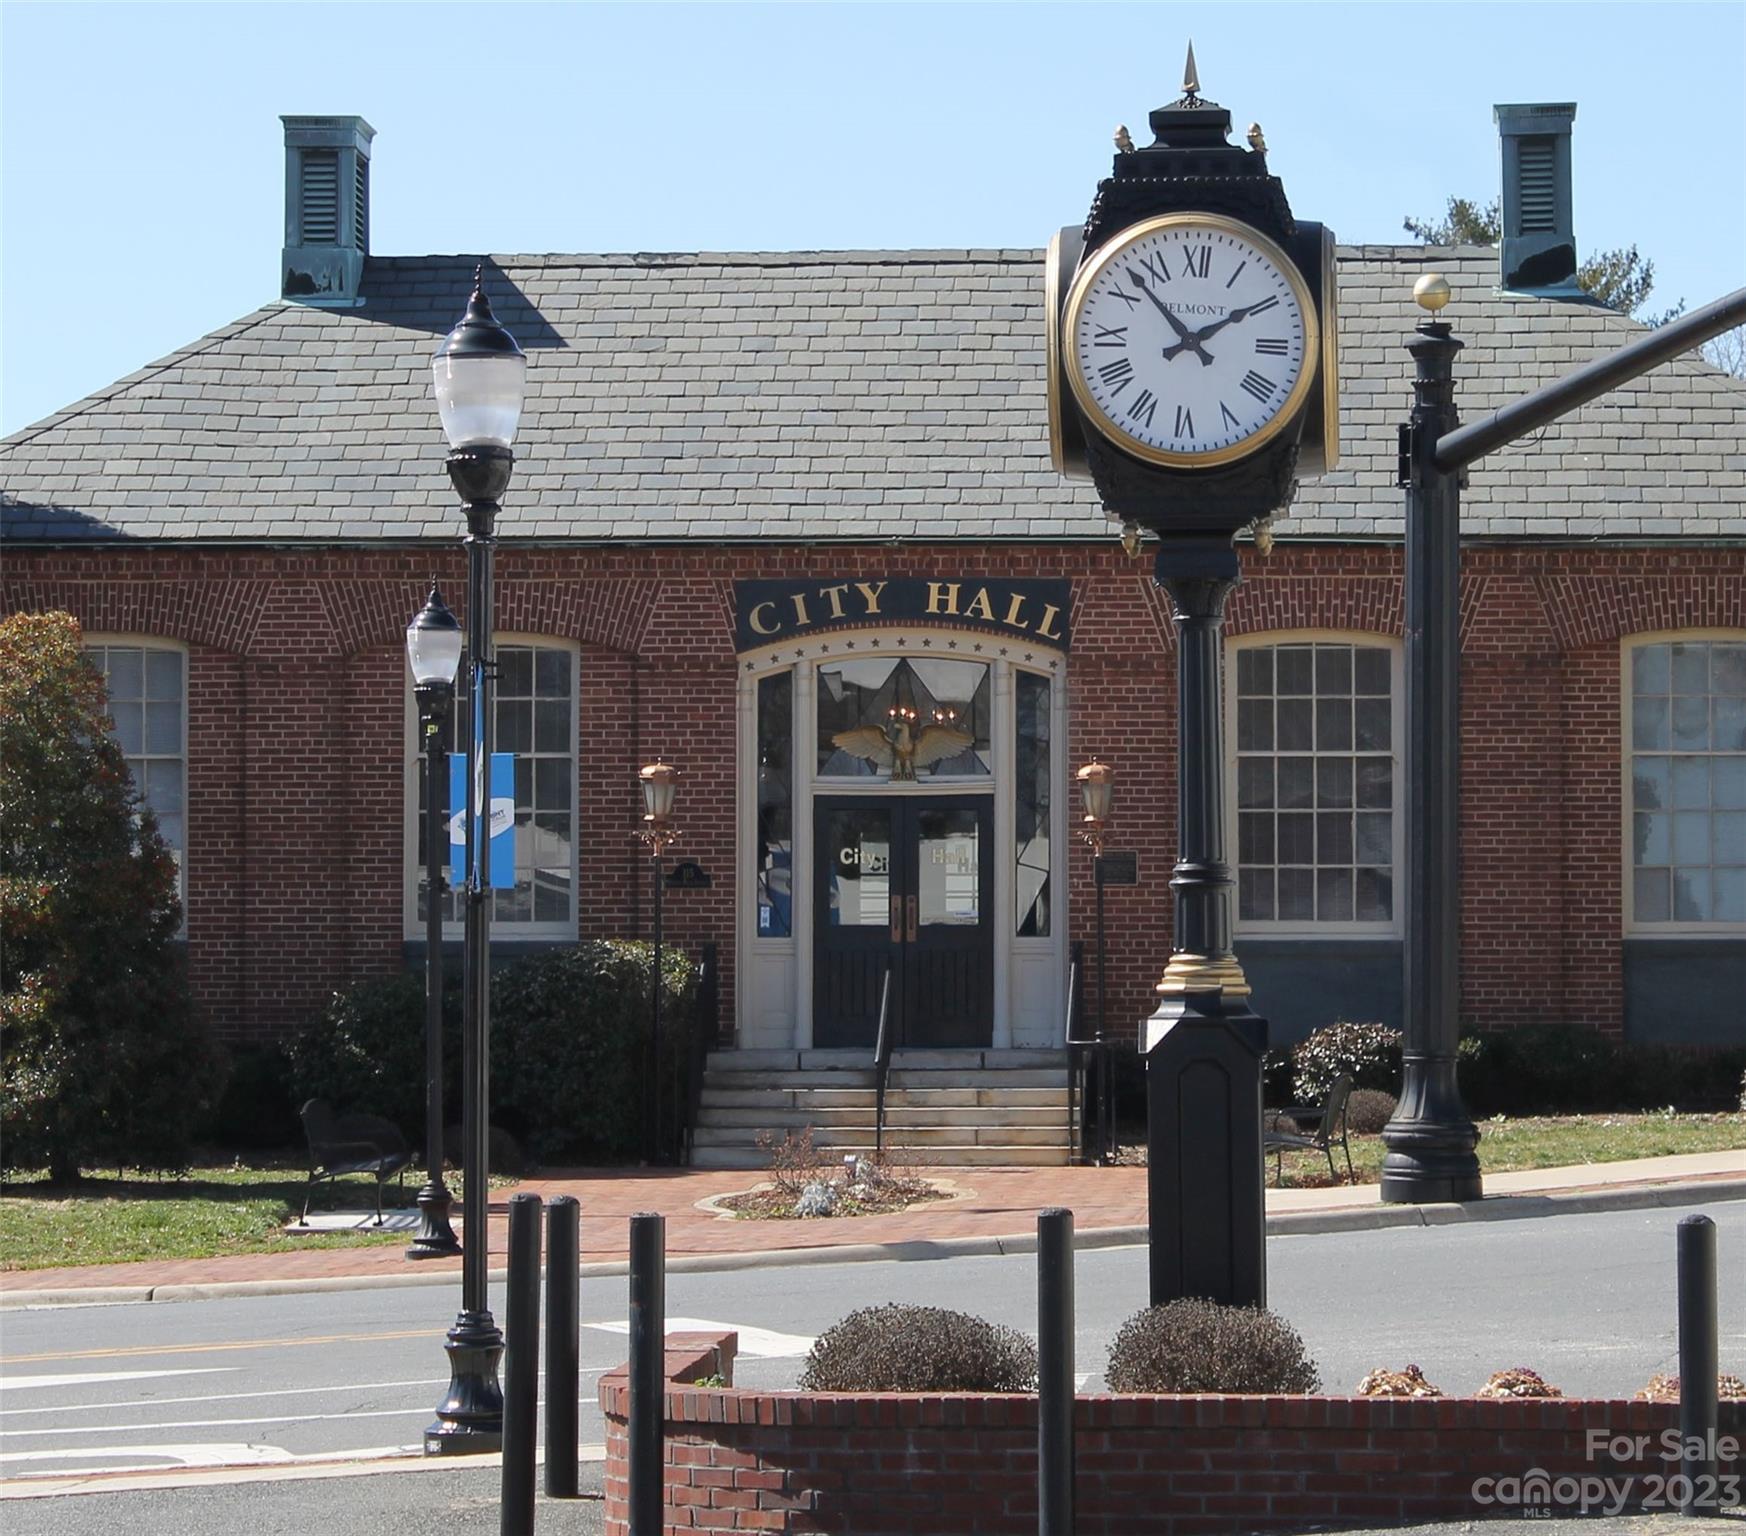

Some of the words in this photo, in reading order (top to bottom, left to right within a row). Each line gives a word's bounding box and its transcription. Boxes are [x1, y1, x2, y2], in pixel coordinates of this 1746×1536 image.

[1139, 250, 1171, 290] XI
[1182, 244, 1212, 278] XII
[1107, 282, 1142, 312] X
[1093, 323, 1128, 347] IX
[1255, 338, 1288, 356] III
[1098, 357, 1136, 398] VIII
[1240, 369, 1277, 403] IIII
[1127, 389, 1159, 428] VII
[1174, 405, 1195, 439] VI
[1220, 401, 1241, 431] V
[749, 581, 888, 635] CITY
[924, 582, 1062, 640] HALL
[840, 847, 875, 868] City
